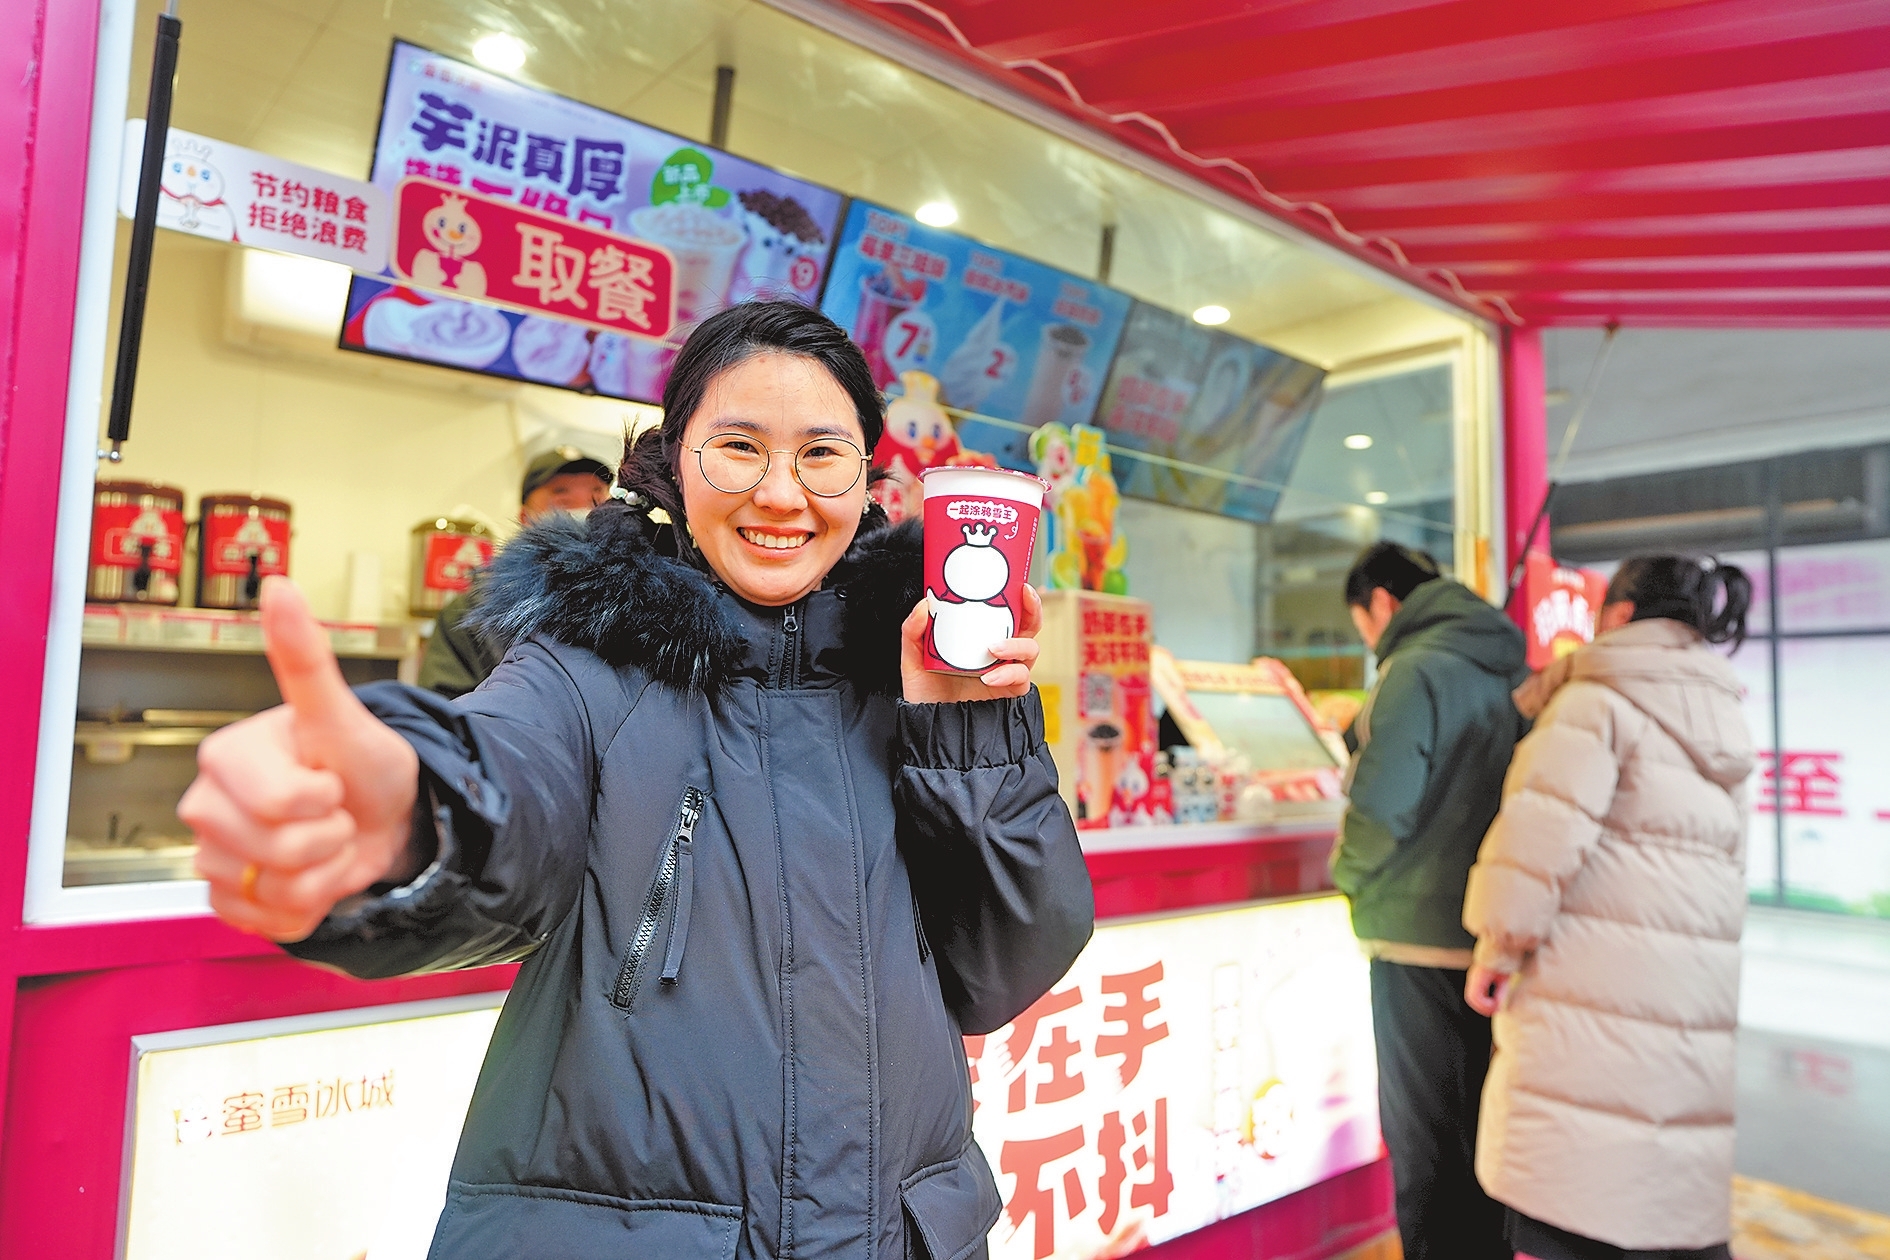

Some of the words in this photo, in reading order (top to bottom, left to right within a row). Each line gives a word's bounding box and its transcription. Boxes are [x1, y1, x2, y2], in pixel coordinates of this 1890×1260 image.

[412, 93, 624, 201] 芋泥真厚
[251, 171, 370, 224] 节约粮食
[248, 202, 369, 254] 拒绝浪费
[513, 222, 656, 330] 取餐
[897, 320, 920, 358] 7
[985, 349, 1004, 379] 2
[949, 503, 1013, 521] 一起涂鸦雪王
[221, 1069, 394, 1136] 蜜雪冰城
[999, 1096, 1175, 1259] 不抖
